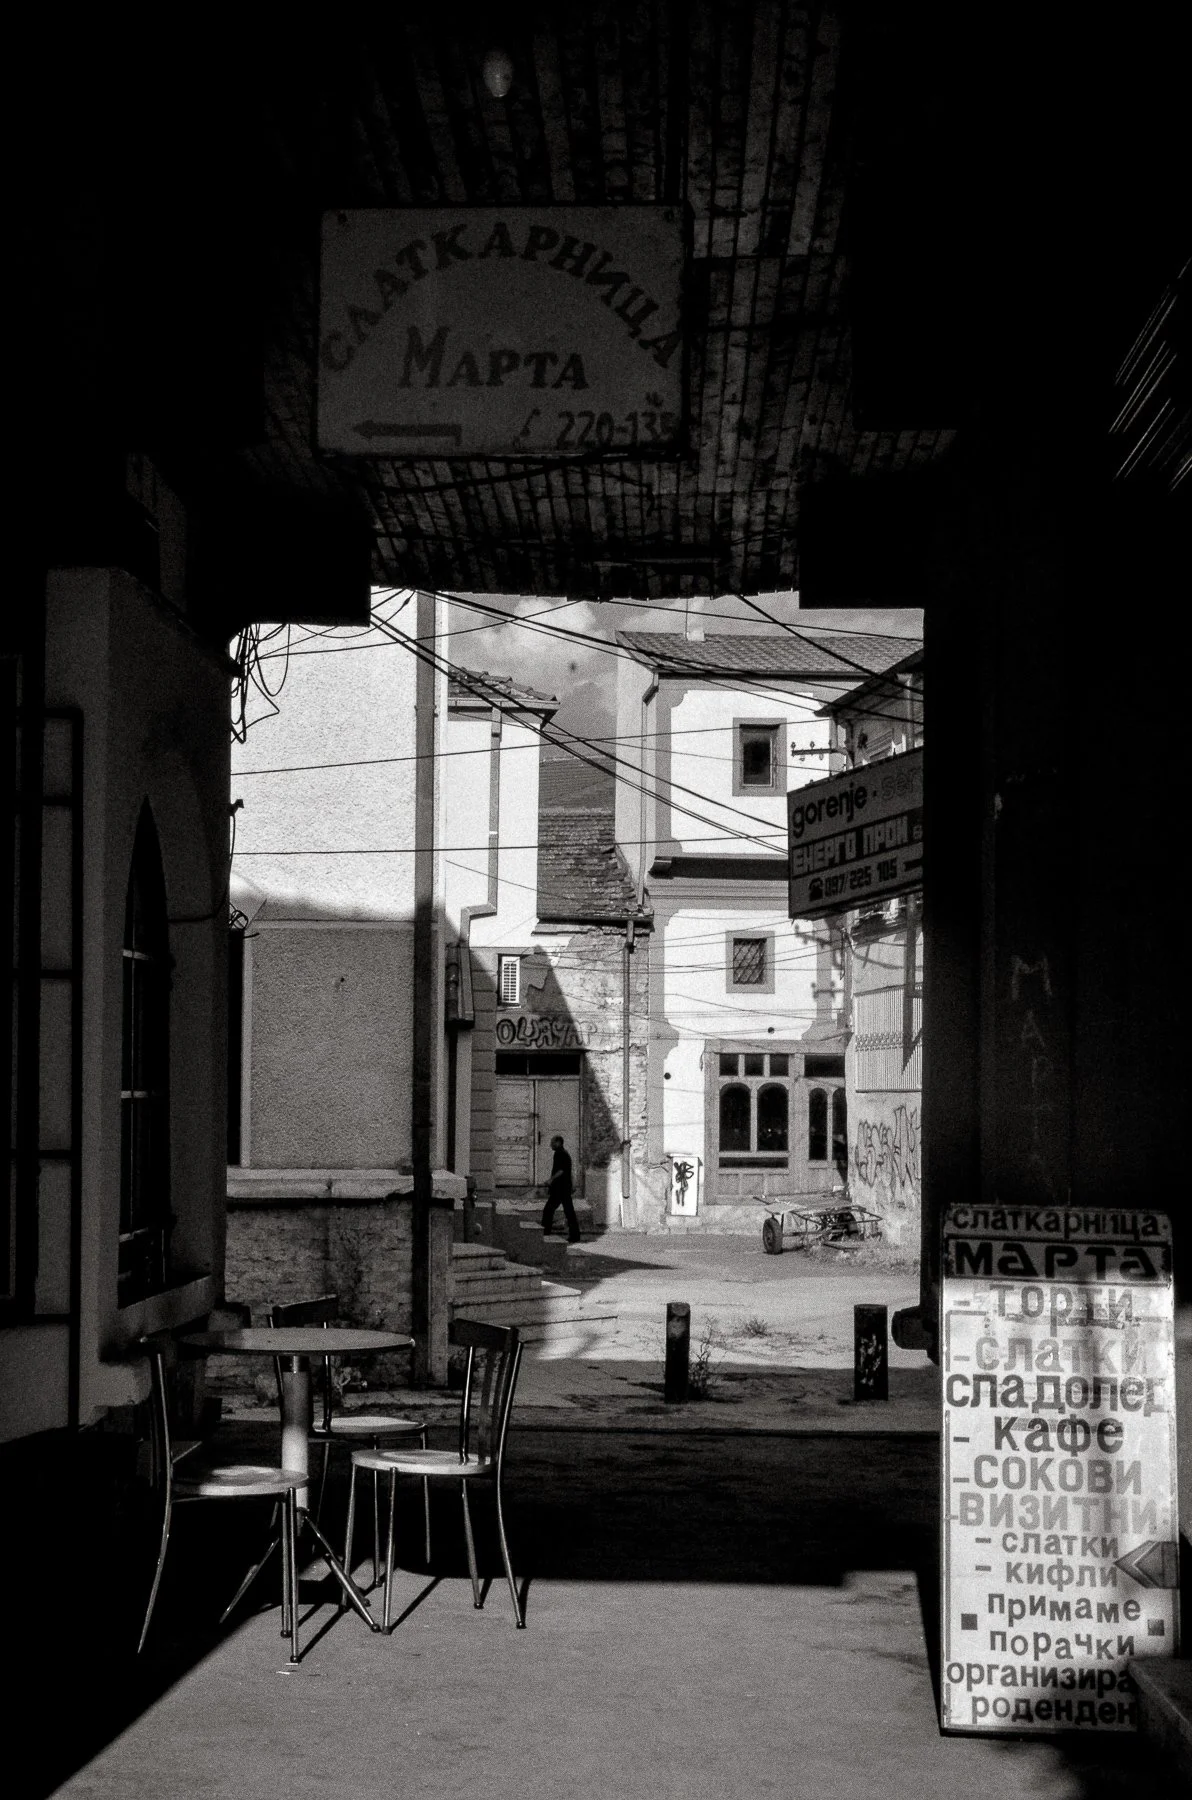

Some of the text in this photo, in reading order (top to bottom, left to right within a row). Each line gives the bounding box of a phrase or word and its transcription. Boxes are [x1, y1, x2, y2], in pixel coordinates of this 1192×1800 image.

[319, 221, 683, 372] СЛАТКАРНИЦА
[792, 782, 867, 839] gorenje
[792, 830, 857, 874] ЕНЕРГО
[952, 1207, 1160, 1240] слаткарница
[994, 1414, 1124, 1457] кафе
[1001, 1532, 1119, 1558] слатки
[1005, 1558, 1118, 1592] кифли
[988, 1593, 1141, 1627] примаме
[990, 1630, 1135, 1661] порачки
[971, 1696, 1137, 1725] роденден
